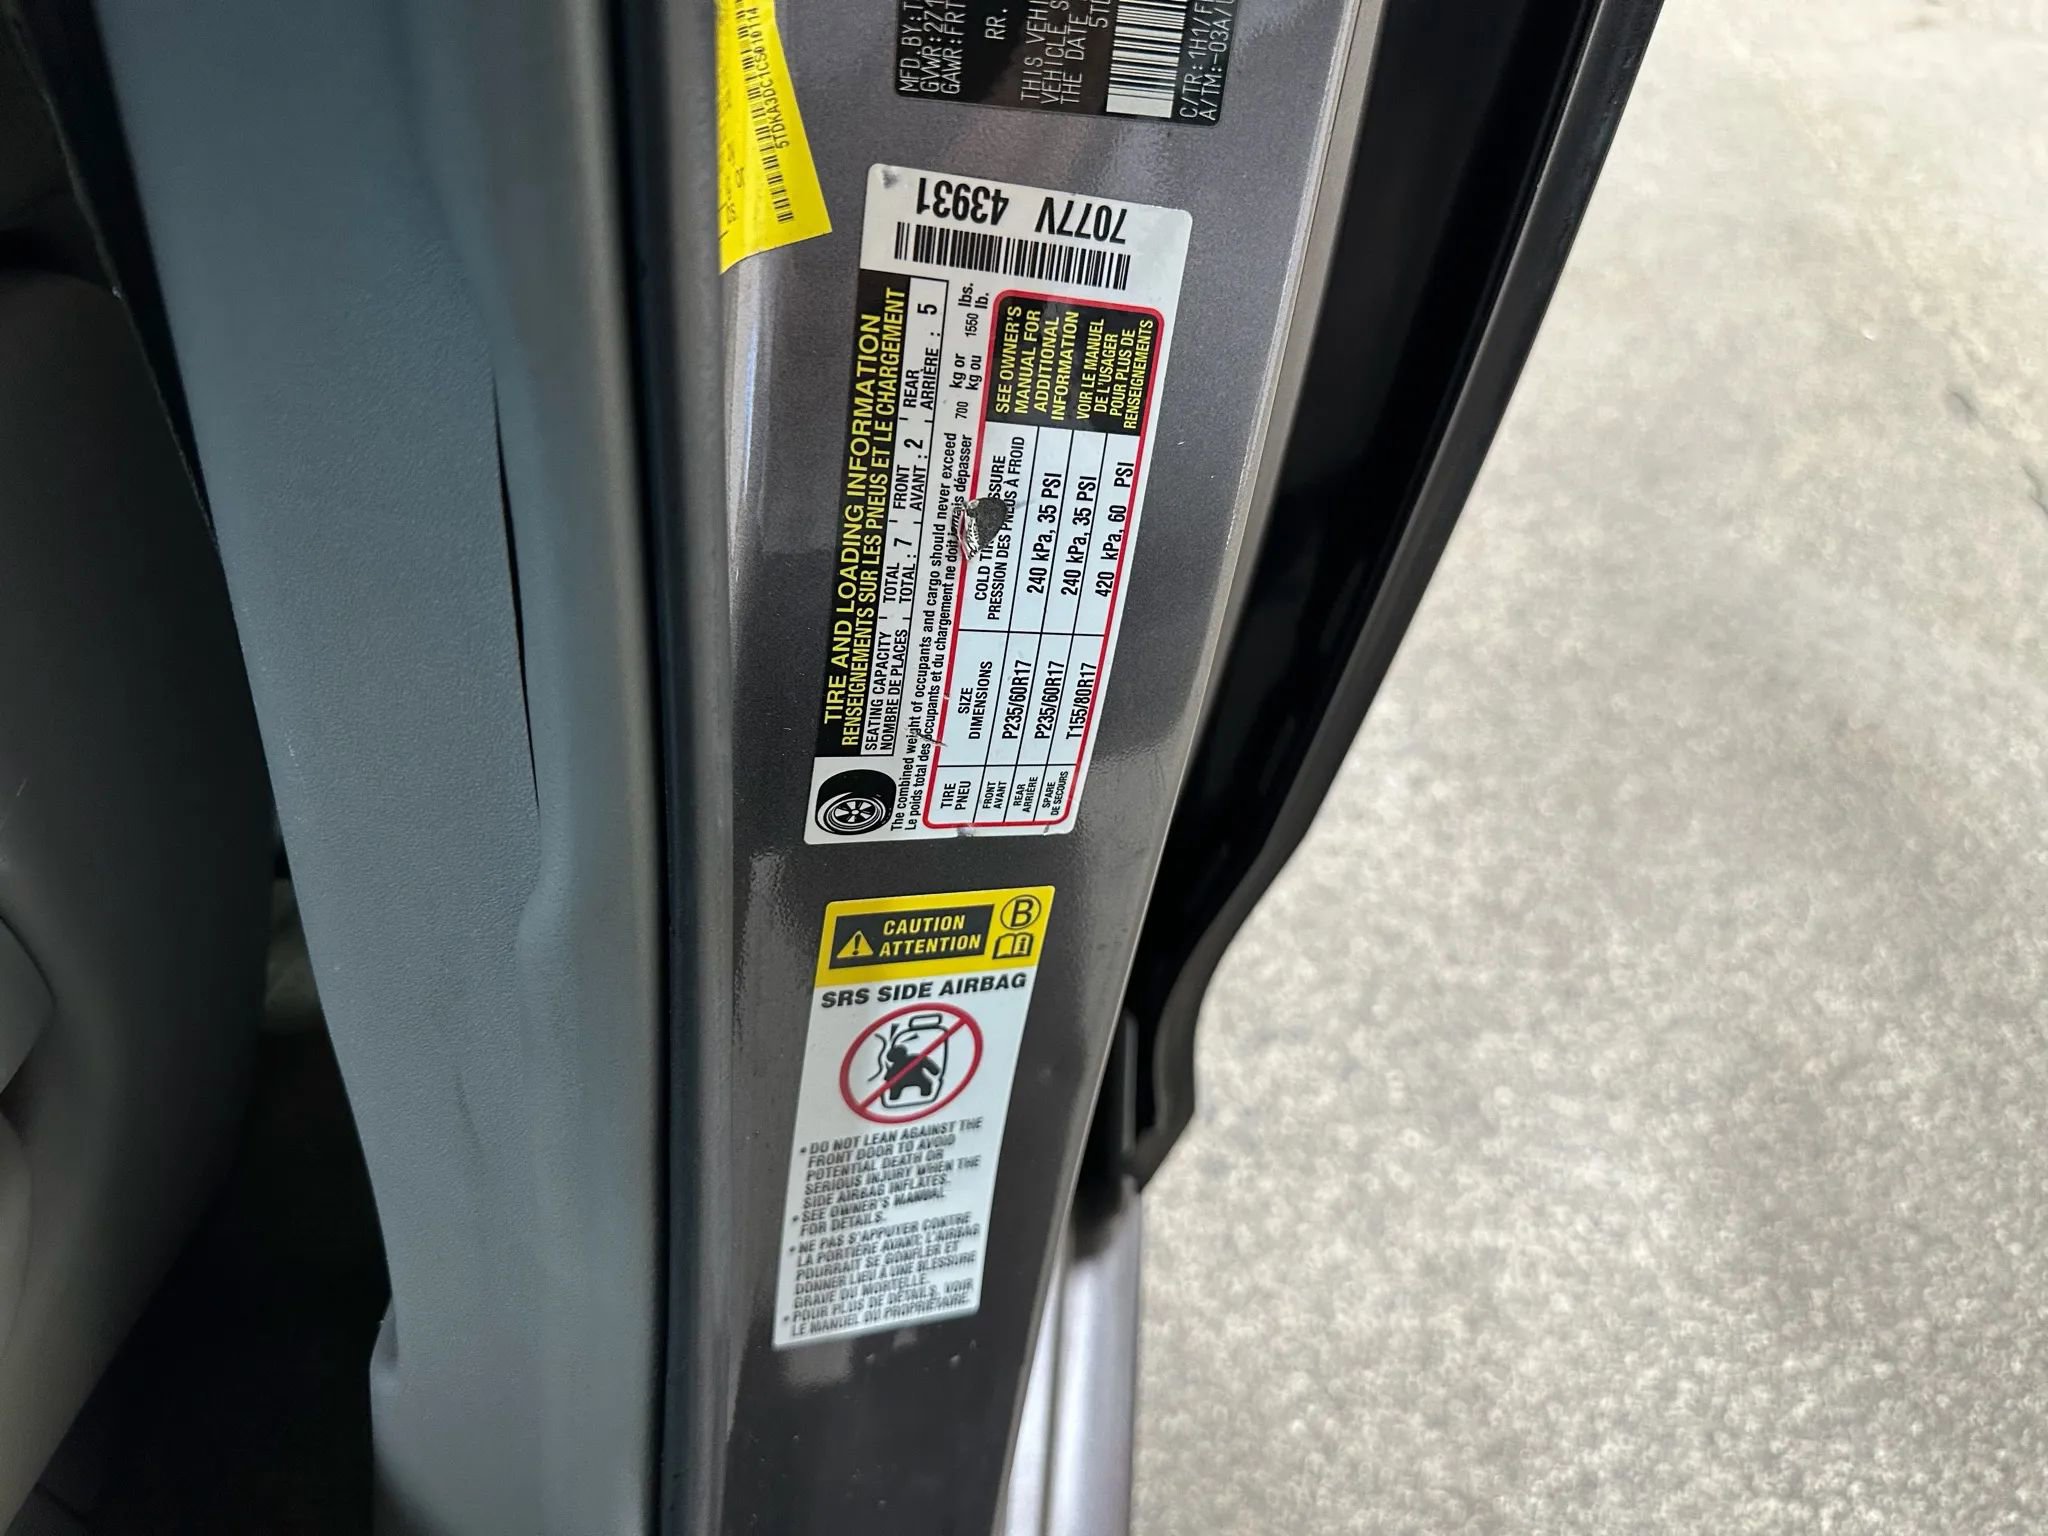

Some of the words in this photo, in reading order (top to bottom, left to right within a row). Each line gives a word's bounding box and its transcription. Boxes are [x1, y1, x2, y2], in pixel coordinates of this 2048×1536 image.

[983, 7, 1008, 40] RR.
[1063, 12, 1089, 60] DATE
[1039, 23, 1067, 105] VEHICLE
[1177, 0, 1214, 118] C/TR:1H1/F
[1019, 56, 1044, 102] THIS
[1059, 70, 1083, 106] THE
[915, 176, 1010, 225] 43931
[1035, 196, 1128, 244] 7077V
[917, 303, 937, 315] 5
[957, 283, 973, 307] lbs.
[974, 292, 988, 309] lb.
[964, 312, 978, 336] 1550
[1023, 310, 1040, 341] FOR
[1120, 329, 1135, 346] DE
[876, 288, 904, 415] CHARGEMENT
[954, 353, 965, 367] or
[1083, 319, 1103, 370] MANUEL
[970, 354, 981, 370] ou
[1033, 317, 1059, 412] ADDITIONAL
[1051, 311, 1078, 420] INFORMATION
[1114, 349, 1131, 380] PLUS
[1123, 320, 1152, 428] RENSEIGNEMENTS
[902, 369, 919, 407] REAR
[920, 347, 940, 410] ARRIÈRE
[948, 371, 965, 388] kg
[965, 374, 982, 390] kg
[1014, 347, 1035, 413] MANUAL
[1080, 373, 1095, 387] LE
[847, 314, 880, 495] INFORMATION
[954, 401, 968, 418] 700
[995, 383, 1012, 413] SEE
[1076, 391, 1092, 419] VOIR
[1093, 396, 1108, 412] DE
[1109, 383, 1126, 416] POUR
[873, 420, 892, 440] LE
[903, 438, 923, 449] 2
[871, 448, 889, 467] ET
[941, 432, 956, 478] exceed
[953, 434, 971, 492] dépasser
[1006, 436, 1026, 475] FROID
[892, 464, 909, 509] FRONT
[909, 464, 928, 511] AVANT
[1002, 476, 1020, 487] À
[1040, 472, 1061, 498] PSI
[1076, 475, 1096, 501] PSI
[1112, 461, 1135, 488] PSI
[865, 473, 887, 528] PNEUS
[937, 482, 950, 519] never
[1037, 504, 1056, 523] 35
[1072, 507, 1091, 525] 35
[1106, 503, 1127, 523] 60
[861, 534, 881, 564] LES
[893, 537, 912, 546] 7
[929, 523, 945, 566] should
[944, 539, 958, 562] doit
[994, 533, 1012, 558] DES
[1031, 529, 1055, 561] kPa,
[1065, 532, 1089, 563] kPa,
[1100, 527, 1125, 560] kPa,
[836, 505, 863, 612] LOADING
[858, 570, 878, 602] SUR
[882, 562, 899, 603] TOTAL
[898, 563, 915, 603] TOTAL
[926, 570, 941, 605] cargo
[941, 565, 955, 585] ne
[972, 565, 991, 600] COLD
[985, 561, 1008, 620] PRESSION
[1026, 567, 1047, 593] 240
[1060, 569, 1081, 595] 240
[1093, 570, 1115, 597] 420
[922, 610, 934, 632] and
[934, 587, 952, 650] chargement
[831, 620, 852, 667] AND
[890, 629, 908, 676] PLACES
[872, 631, 891, 694] CAPACITY
[914, 636, 935, 697] occupants
[929, 653, 944, 668] du
[930, 670, 942, 681] et
[842, 608, 873, 745] RENSEIGNEMENTS
[887, 679, 901, 694] DE
[824, 675, 846, 723] TIRE
[910, 700, 922, 712] of
[921, 685, 940, 741] occupants
[957, 687, 973, 713] SIZE
[968, 661, 992, 739] DIMENSIONS
[1001, 660, 1031, 738] P235/60R17
[1034, 661, 1063, 738] P235/60R17
[1065, 662, 1096, 739] T155/80R17
[864, 699, 883, 750] SEATING
[879, 698, 898, 749] NOMBRE
[905, 716, 921, 753] weight
[917, 743, 931, 761] des
[894, 757, 914, 808] combined
[912, 764, 927, 787] total
[1053, 771, 1068, 804] SECOURS
[908, 789, 922, 816] poids
[940, 783, 956, 808] TIRE
[954, 780, 971, 810] PNEU
[982, 781, 995, 808] FRONT
[993, 781, 1006, 808] AVANT
[1012, 783, 1025, 806] REAR
[1022, 776, 1038, 812] ARRIÈRE
[1041, 781, 1055, 808] SPARE
[890, 812, 904, 831] The
[904, 818, 917, 830] Le
[1050, 805, 1060, 815] DE
[881, 913, 966, 937] CAUTION
[1009, 897, 1035, 927] B
[878, 933, 982, 958] ATTENTION
[820, 986, 871, 1009] SRS
[875, 980, 934, 1003] SIDE
[938, 971, 1027, 996] AIRBAG
[809, 1139, 830, 1155] DO
[832, 1135, 861, 1151] NOT
[862, 1129, 898, 1147] LEAN
[899, 1120, 957, 1141] AGAINST
[957, 1116, 984, 1131] THE
[805, 1158, 878, 1182] POTENTIAL
[880, 1150, 923, 1170] DEATH
[807, 1149, 853, 1169] FRONT
[855, 1142, 895, 1161] DOOR
[896, 1139, 915, 1154] TO
[801, 1192, 834, 1210] SIDE
[836, 1182, 886, 1204] AIRBAG
[803, 1173, 863, 1196] SERIOUS
[798, 1220, 828, 1237] FOR
[801, 1207, 826, 1223] SEE
